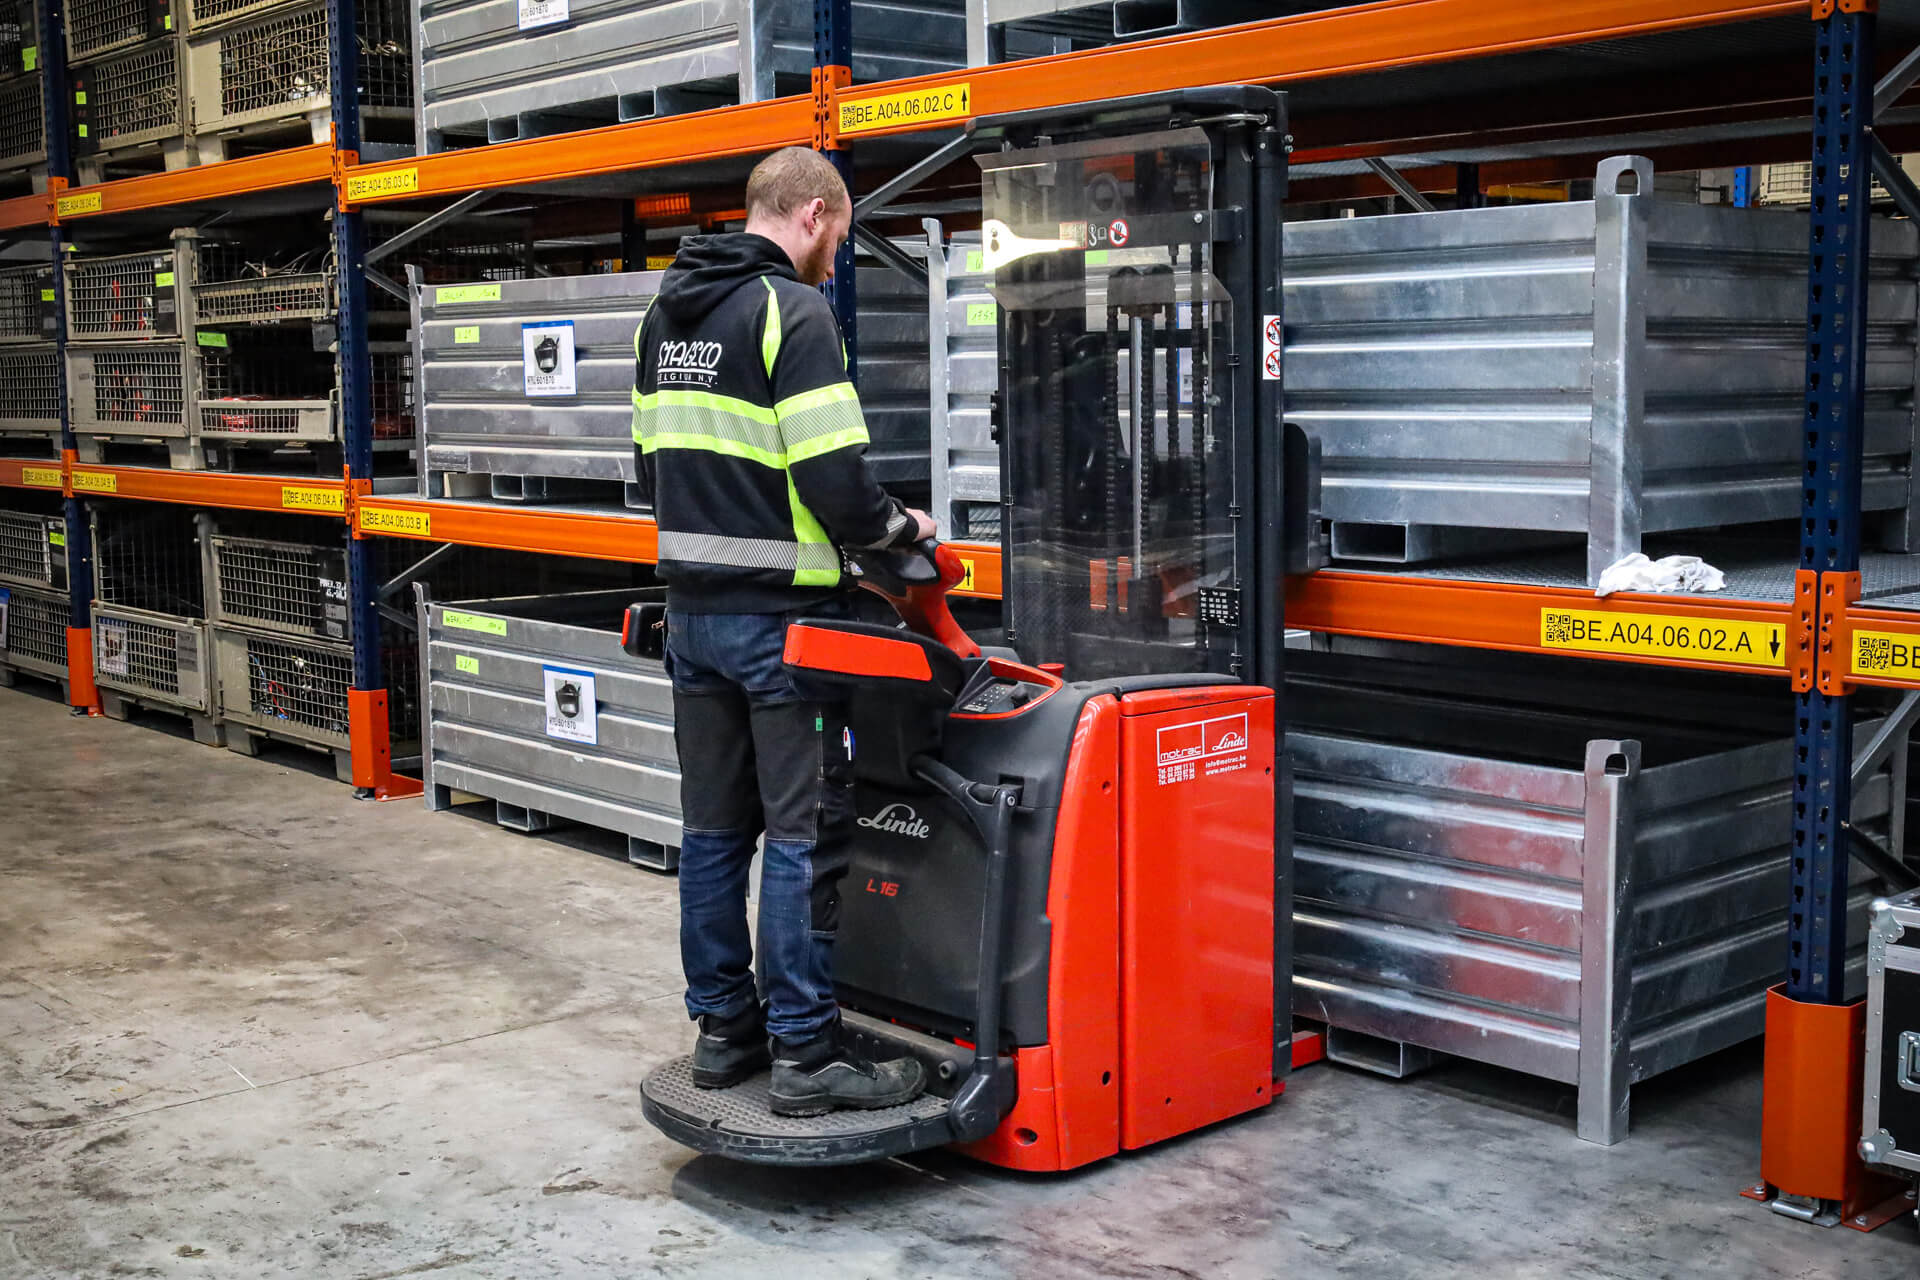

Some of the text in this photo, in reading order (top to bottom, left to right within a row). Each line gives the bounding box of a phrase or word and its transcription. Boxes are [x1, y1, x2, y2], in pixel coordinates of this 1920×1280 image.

[856, 93, 954, 123] BE.A04.06.02.C
[698, 374, 718, 385] N.V.
[290, 491, 337, 506] BE.A04.06.04.A
[369, 512, 421, 530] BE.A04.06.03.B
[1571, 619, 1753, 654] BE.A04.06.02.A
[1211, 731, 1245, 751] Linde
[1160, 746, 1202, 761] motrac
[1205, 763, 1247, 776] www.motrac.be
[857, 803, 929, 838] Linde
[865, 877, 900, 896] L 16
